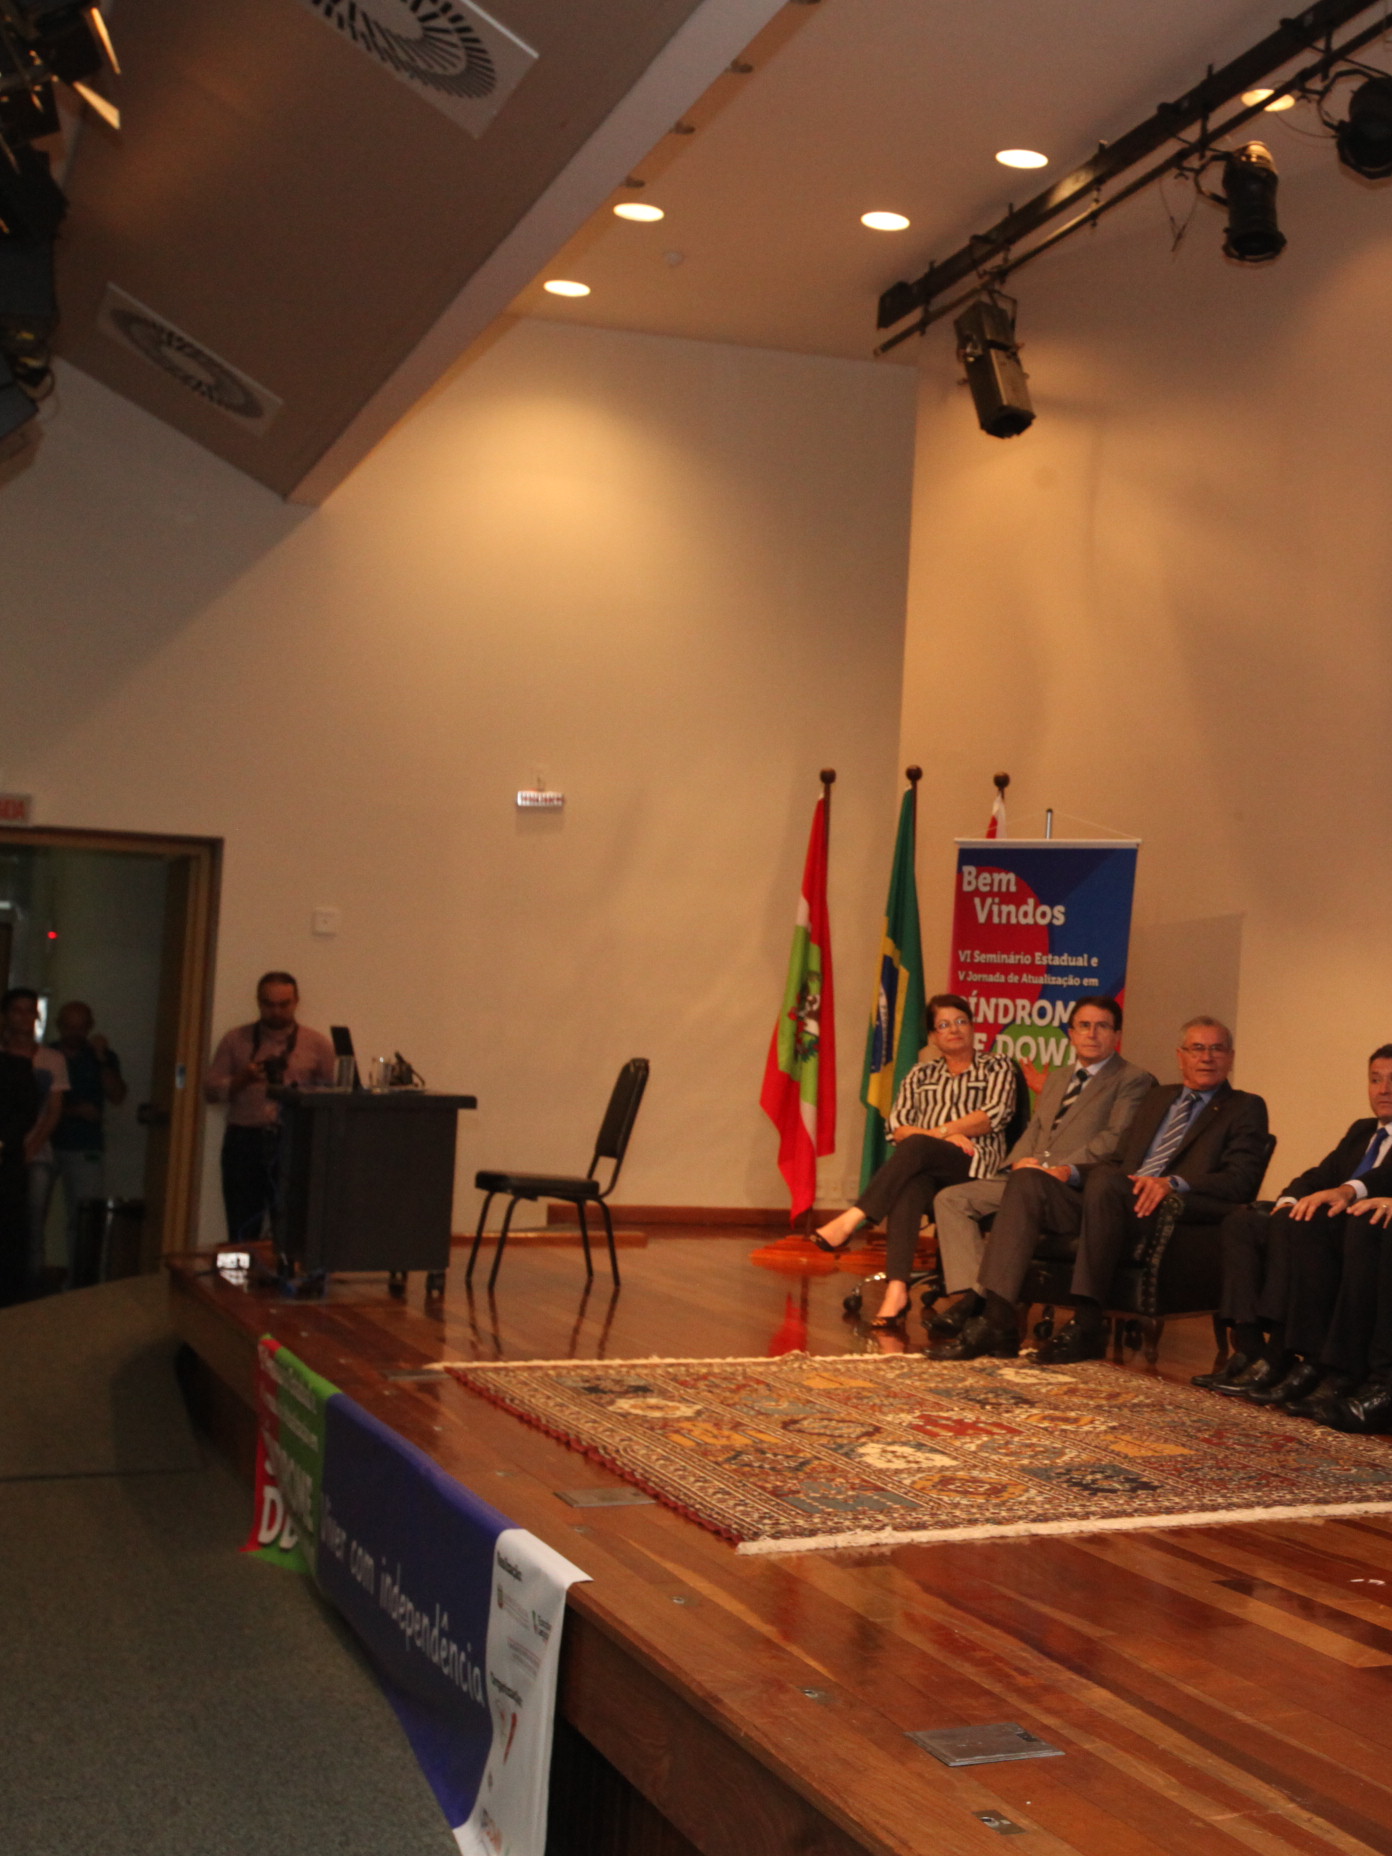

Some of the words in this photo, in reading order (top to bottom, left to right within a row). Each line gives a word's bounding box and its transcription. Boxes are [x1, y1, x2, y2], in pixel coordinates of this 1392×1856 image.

[962, 865, 1016, 893] Bem
[974, 897, 1066, 926] Vindos
[958, 950, 971, 963] VI
[973, 950, 1032, 965] Seminário
[1034, 952, 1088, 967] Estadual
[1091, 956, 1099, 967] e
[958, 970, 966, 980] V
[966, 970, 1005, 983] Jornada
[1007, 973, 1019, 984] de
[1021, 973, 1080, 988] Atualização
[1082, 977, 1099, 987] em
[961, 990, 1077, 1027] ÍNDROM
[379, 1555, 486, 1708] independência
